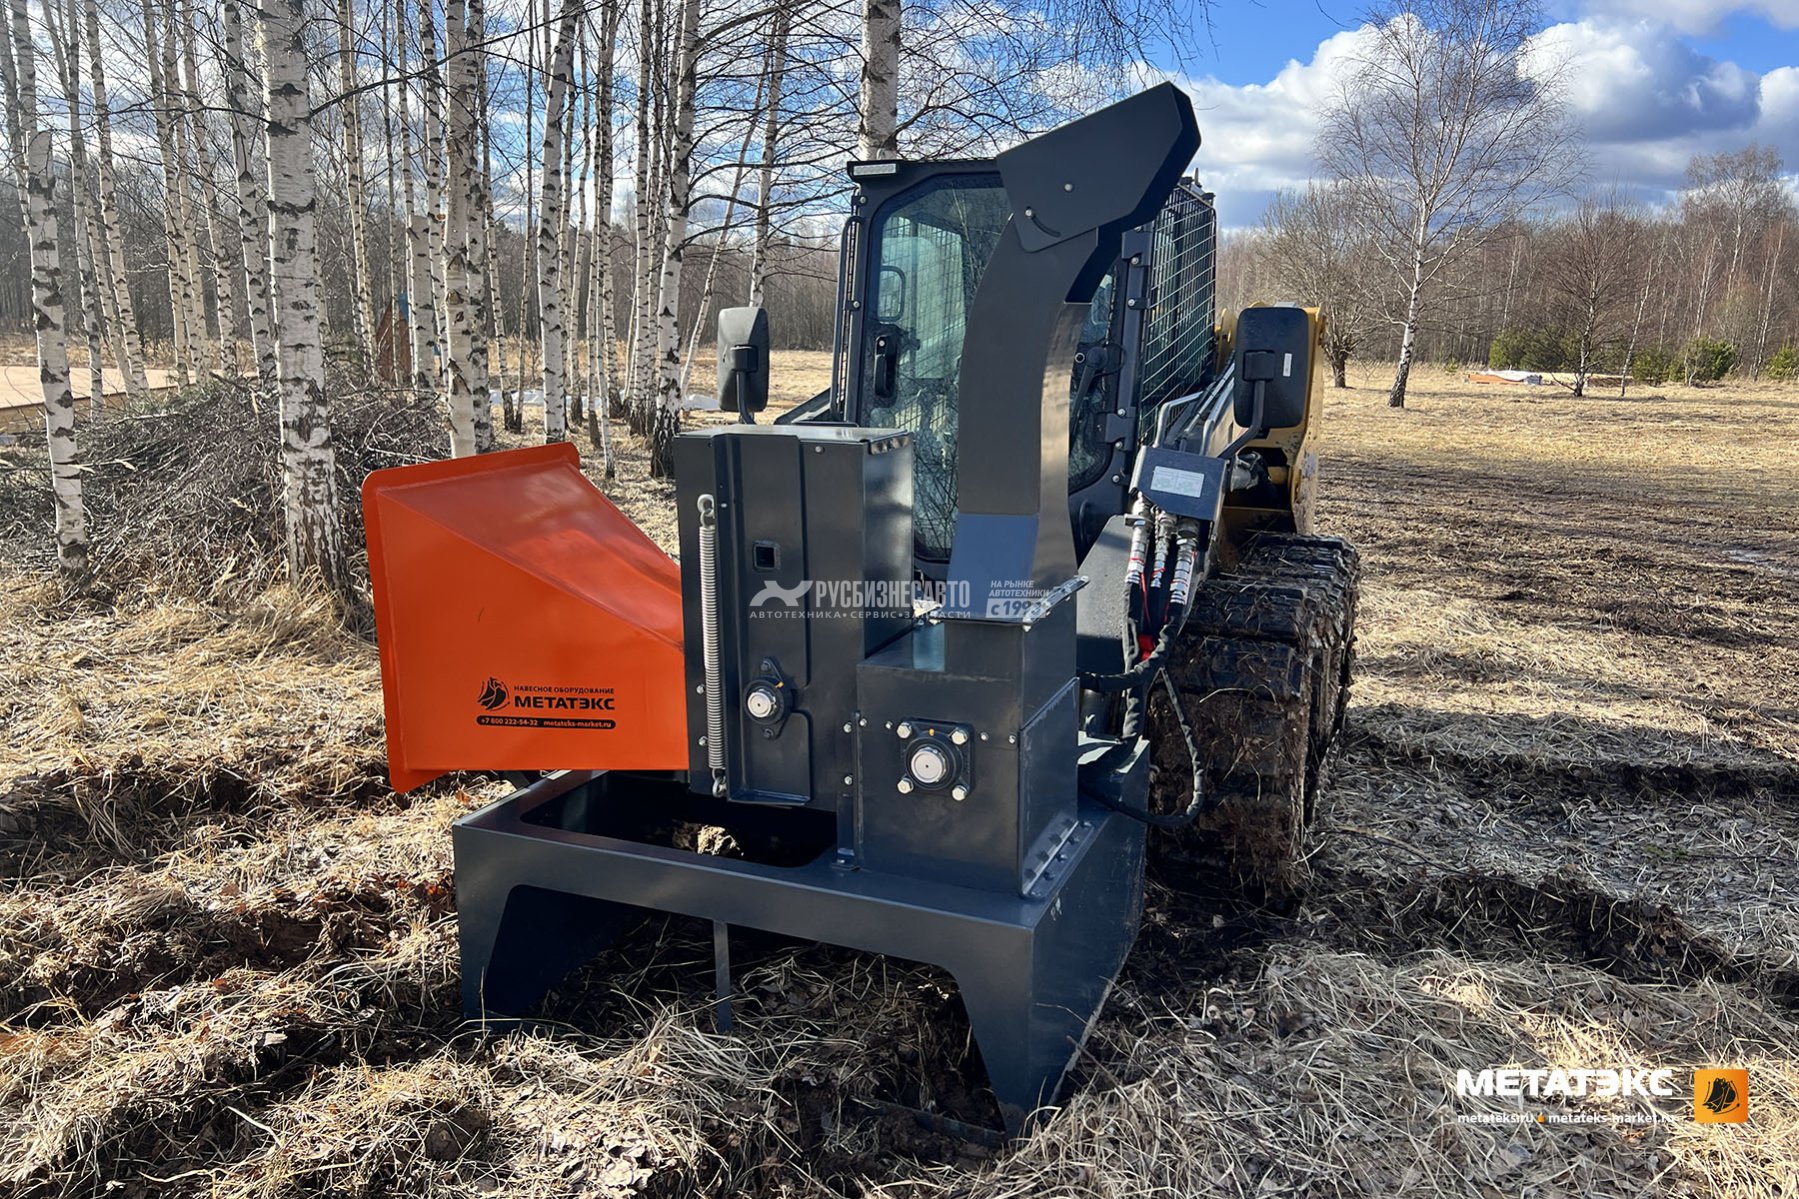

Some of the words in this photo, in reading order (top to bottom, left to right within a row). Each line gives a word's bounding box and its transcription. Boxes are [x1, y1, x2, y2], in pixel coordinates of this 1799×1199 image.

[514, 685, 553, 693] НАВЕСНОЕ
[554, 686, 614, 694] ОБОРУДОВАНИЕ
[514, 695, 615, 710] МЕТАТЭКС
[504, 718, 538, 726] 222-54-32
[543, 720, 612, 728] metateks-market.ru
